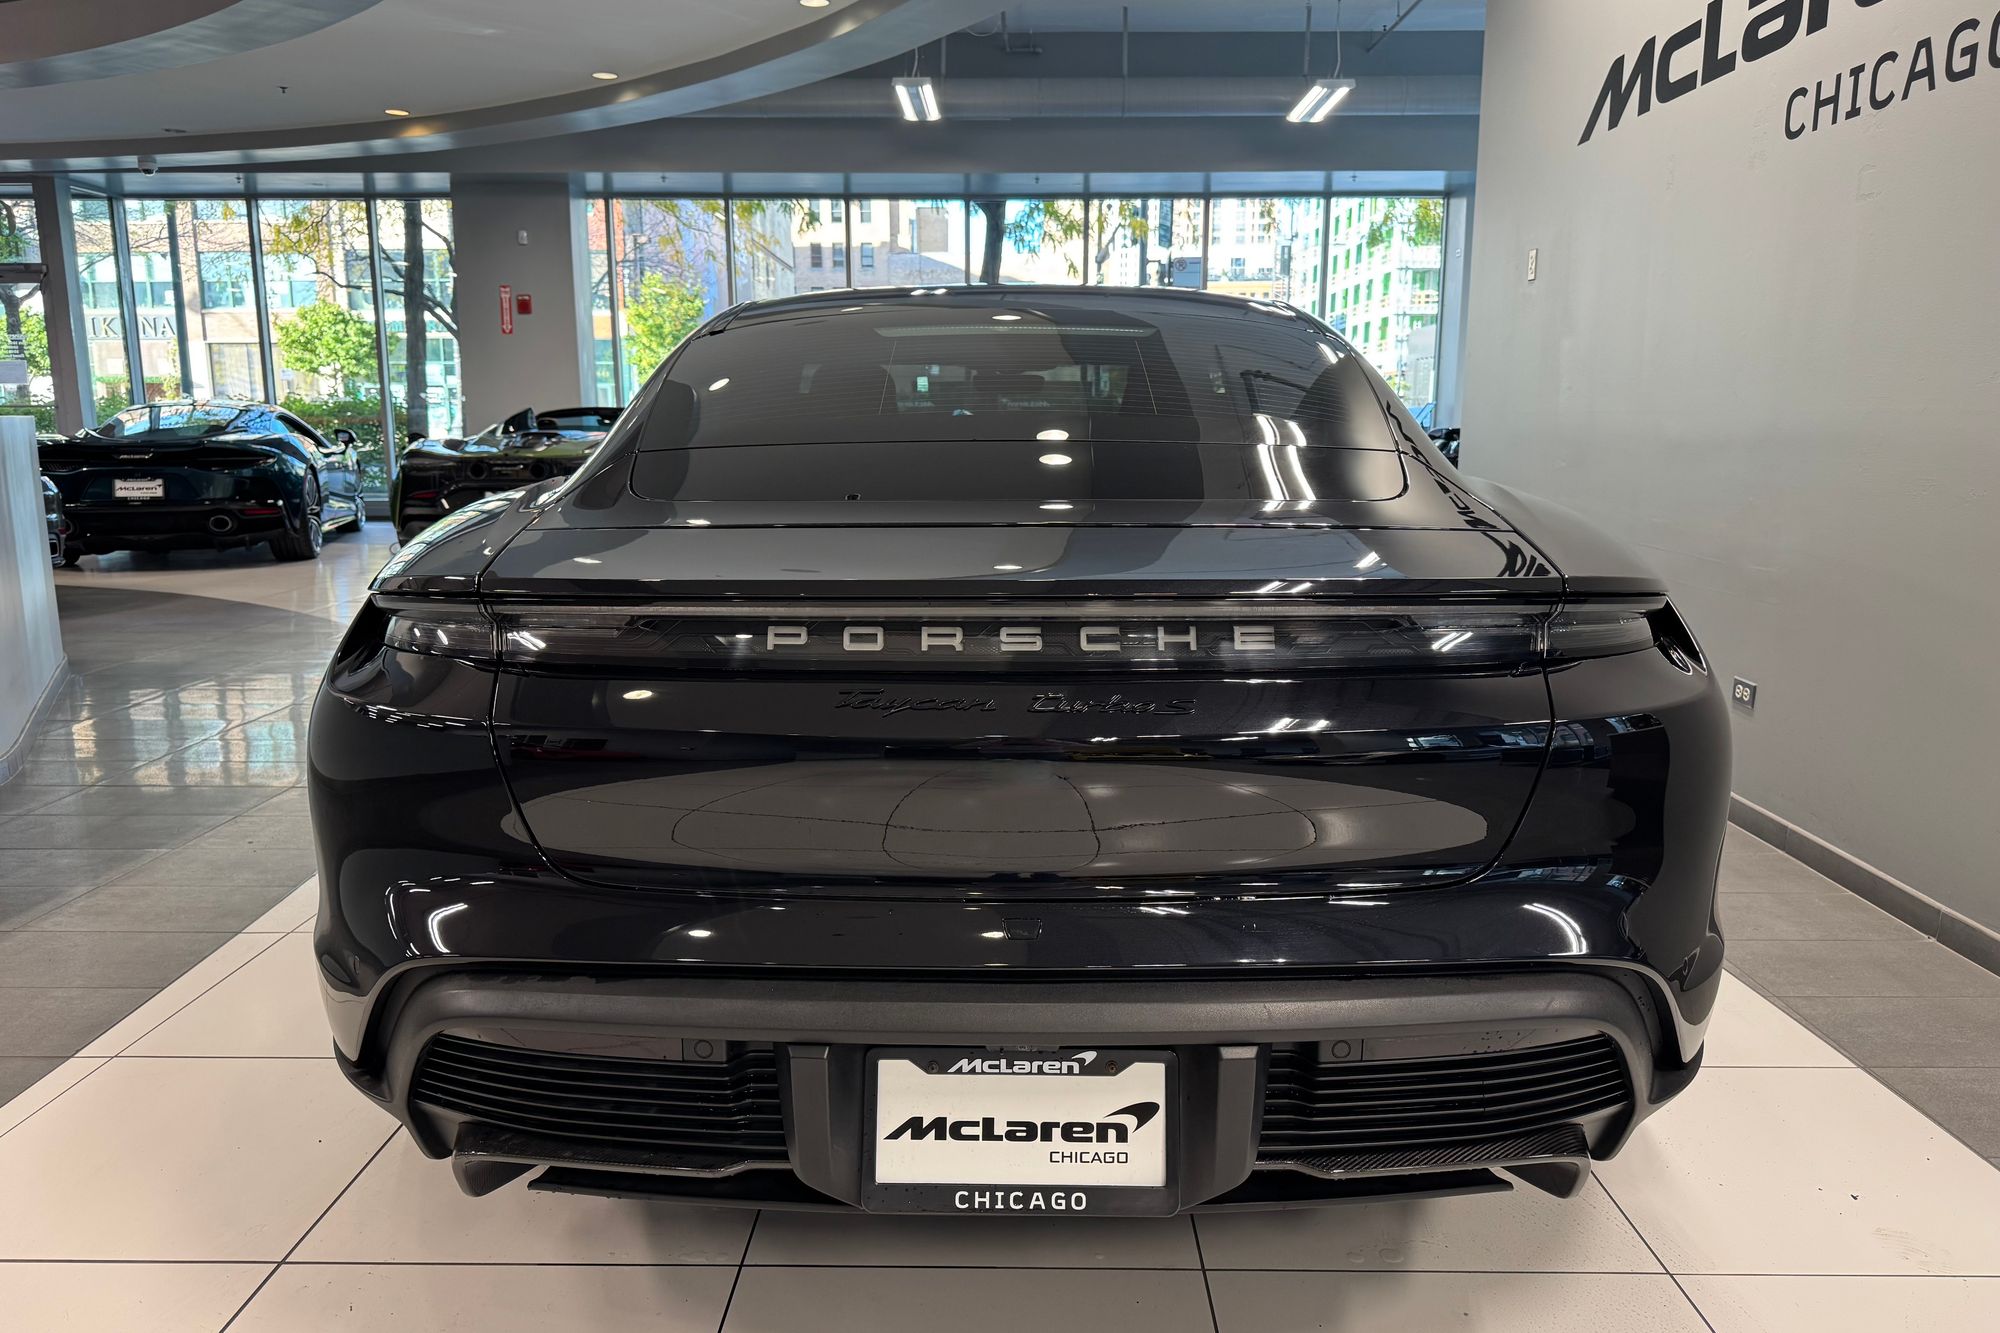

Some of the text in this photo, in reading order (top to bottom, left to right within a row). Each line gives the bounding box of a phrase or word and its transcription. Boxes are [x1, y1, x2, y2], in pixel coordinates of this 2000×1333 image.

[90, 316, 176, 338] IKNA
[767, 626, 1276, 652] PORSCHE
[834, 688, 997, 718] Taycan
[1153, 698, 1197, 715] S
[947, 1058, 1080, 1074] McLaren
[883, 1116, 1129, 1144] McLaren
[1049, 1151, 1129, 1164] CHICAGO
[955, 1190, 1087, 1211] CHICAGO
